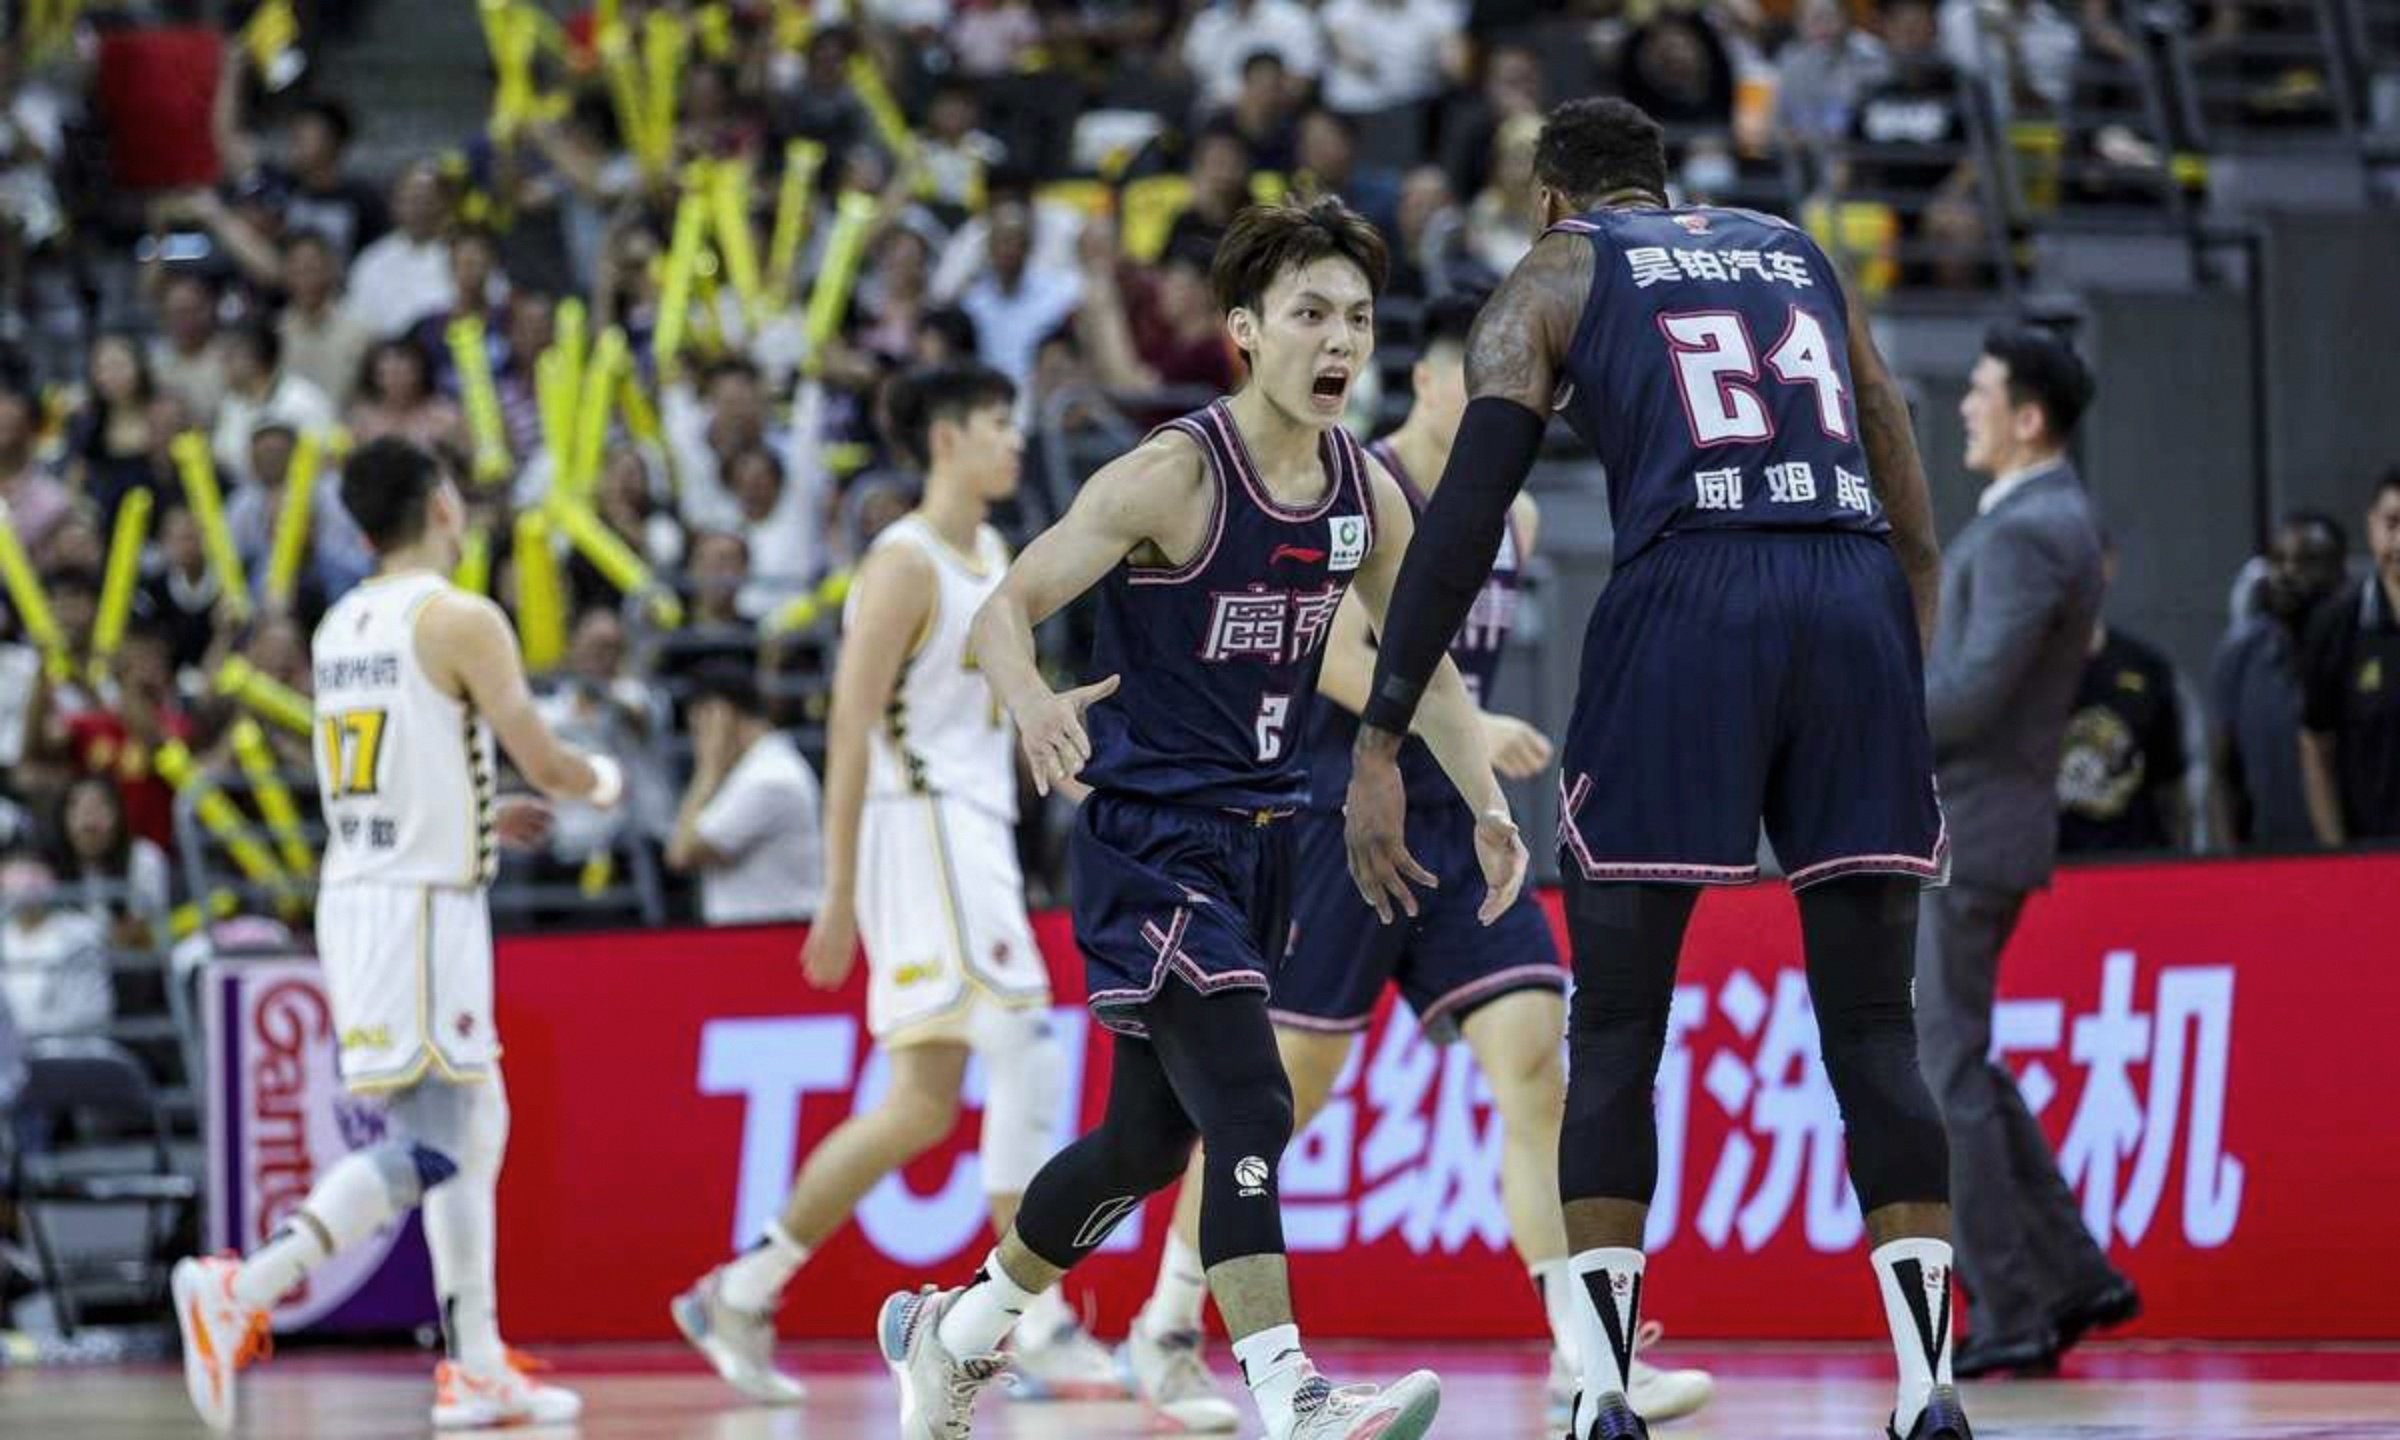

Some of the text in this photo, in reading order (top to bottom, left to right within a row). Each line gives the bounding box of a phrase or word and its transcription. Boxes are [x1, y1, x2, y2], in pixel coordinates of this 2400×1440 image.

[1625, 247, 1814, 289] 昊铂汽车
[1657, 303, 1850, 449] 24
[1694, 460, 1874, 515] 威姆斯
[323, 707, 387, 801] 17
[1255, 692, 1290, 763] 2
